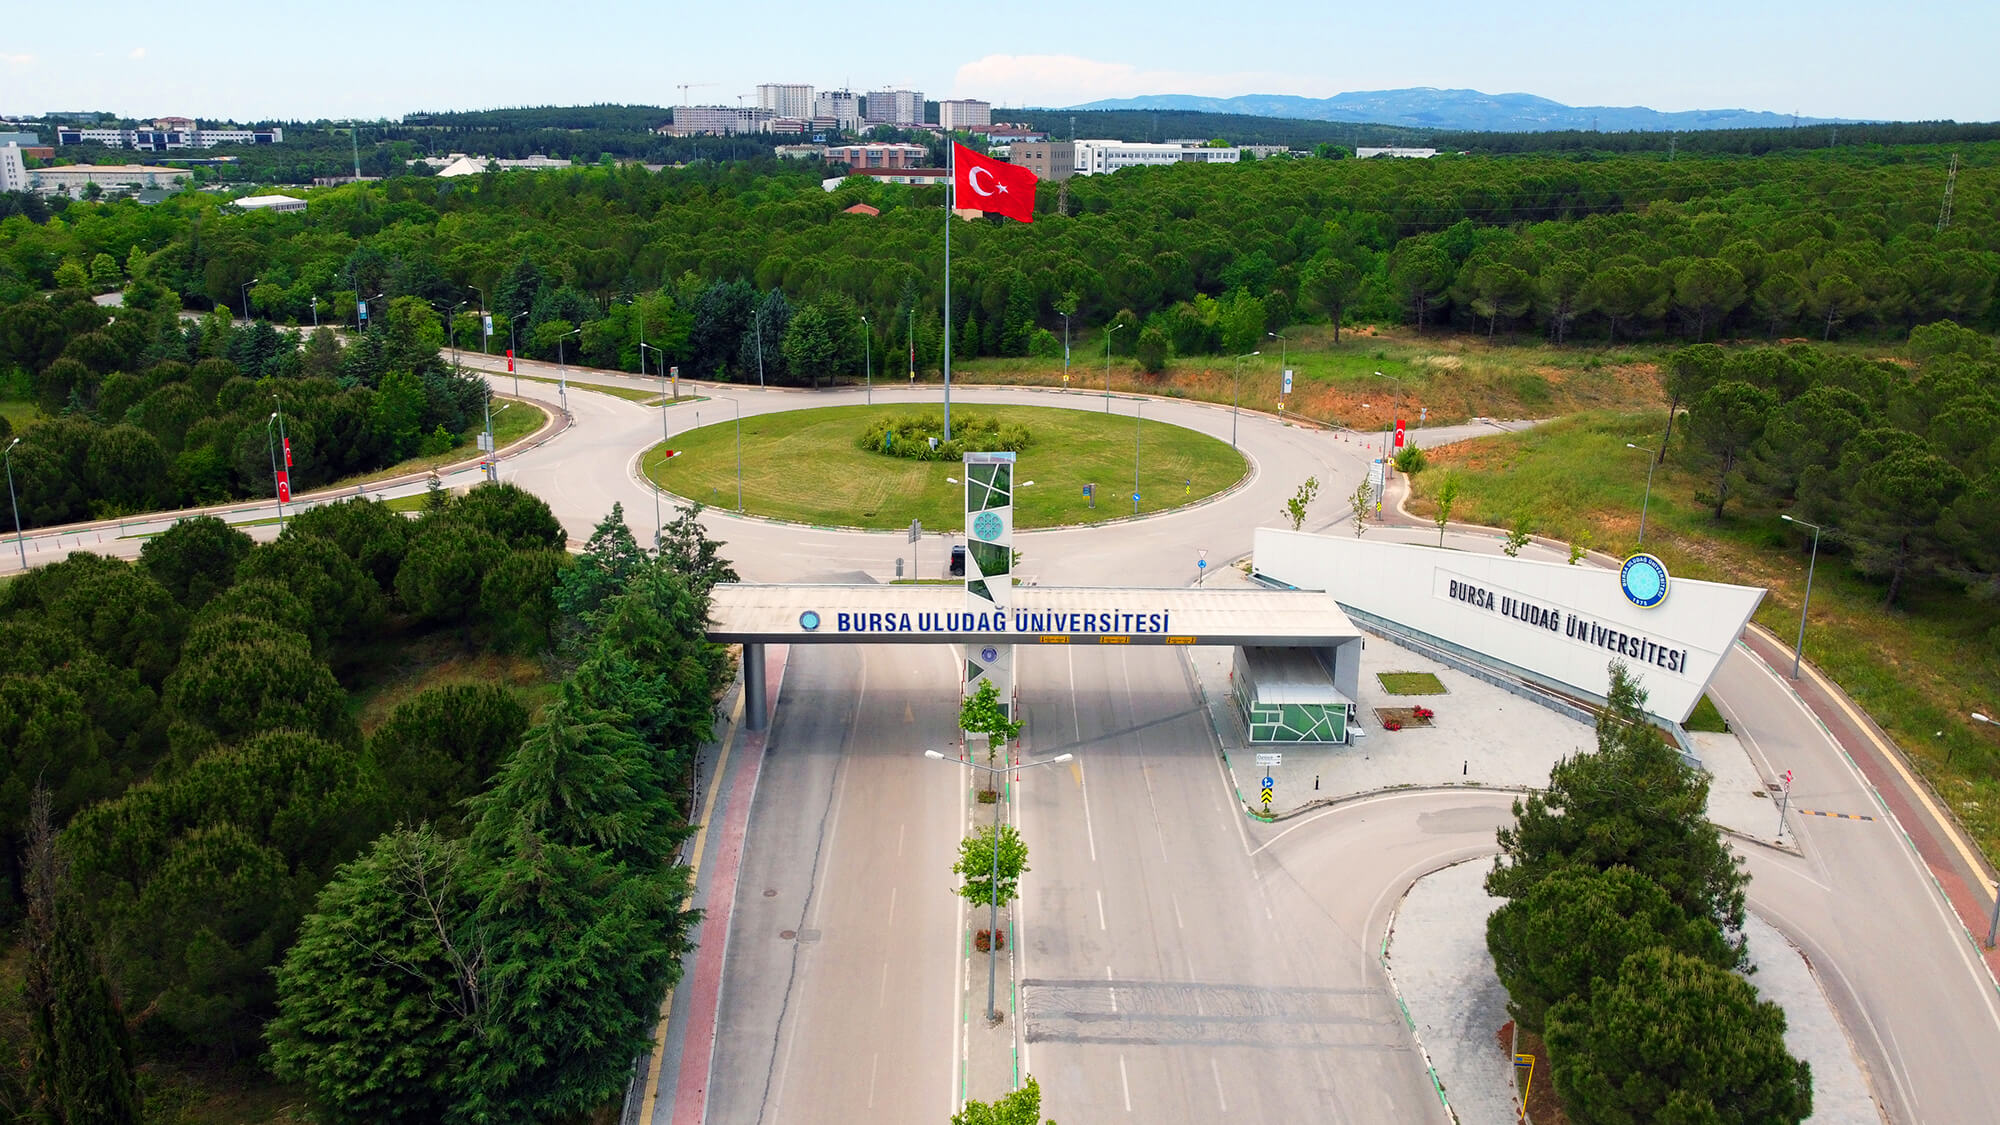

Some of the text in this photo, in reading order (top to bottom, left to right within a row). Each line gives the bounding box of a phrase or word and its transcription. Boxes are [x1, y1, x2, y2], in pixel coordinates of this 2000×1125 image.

[838, 605, 1169, 633] BURSA ULUDAĞ ÜNİVERSİTESİ
[1449, 579, 1688, 674] BURSA ULUDAĞ ÜNİVERSİTESİ
